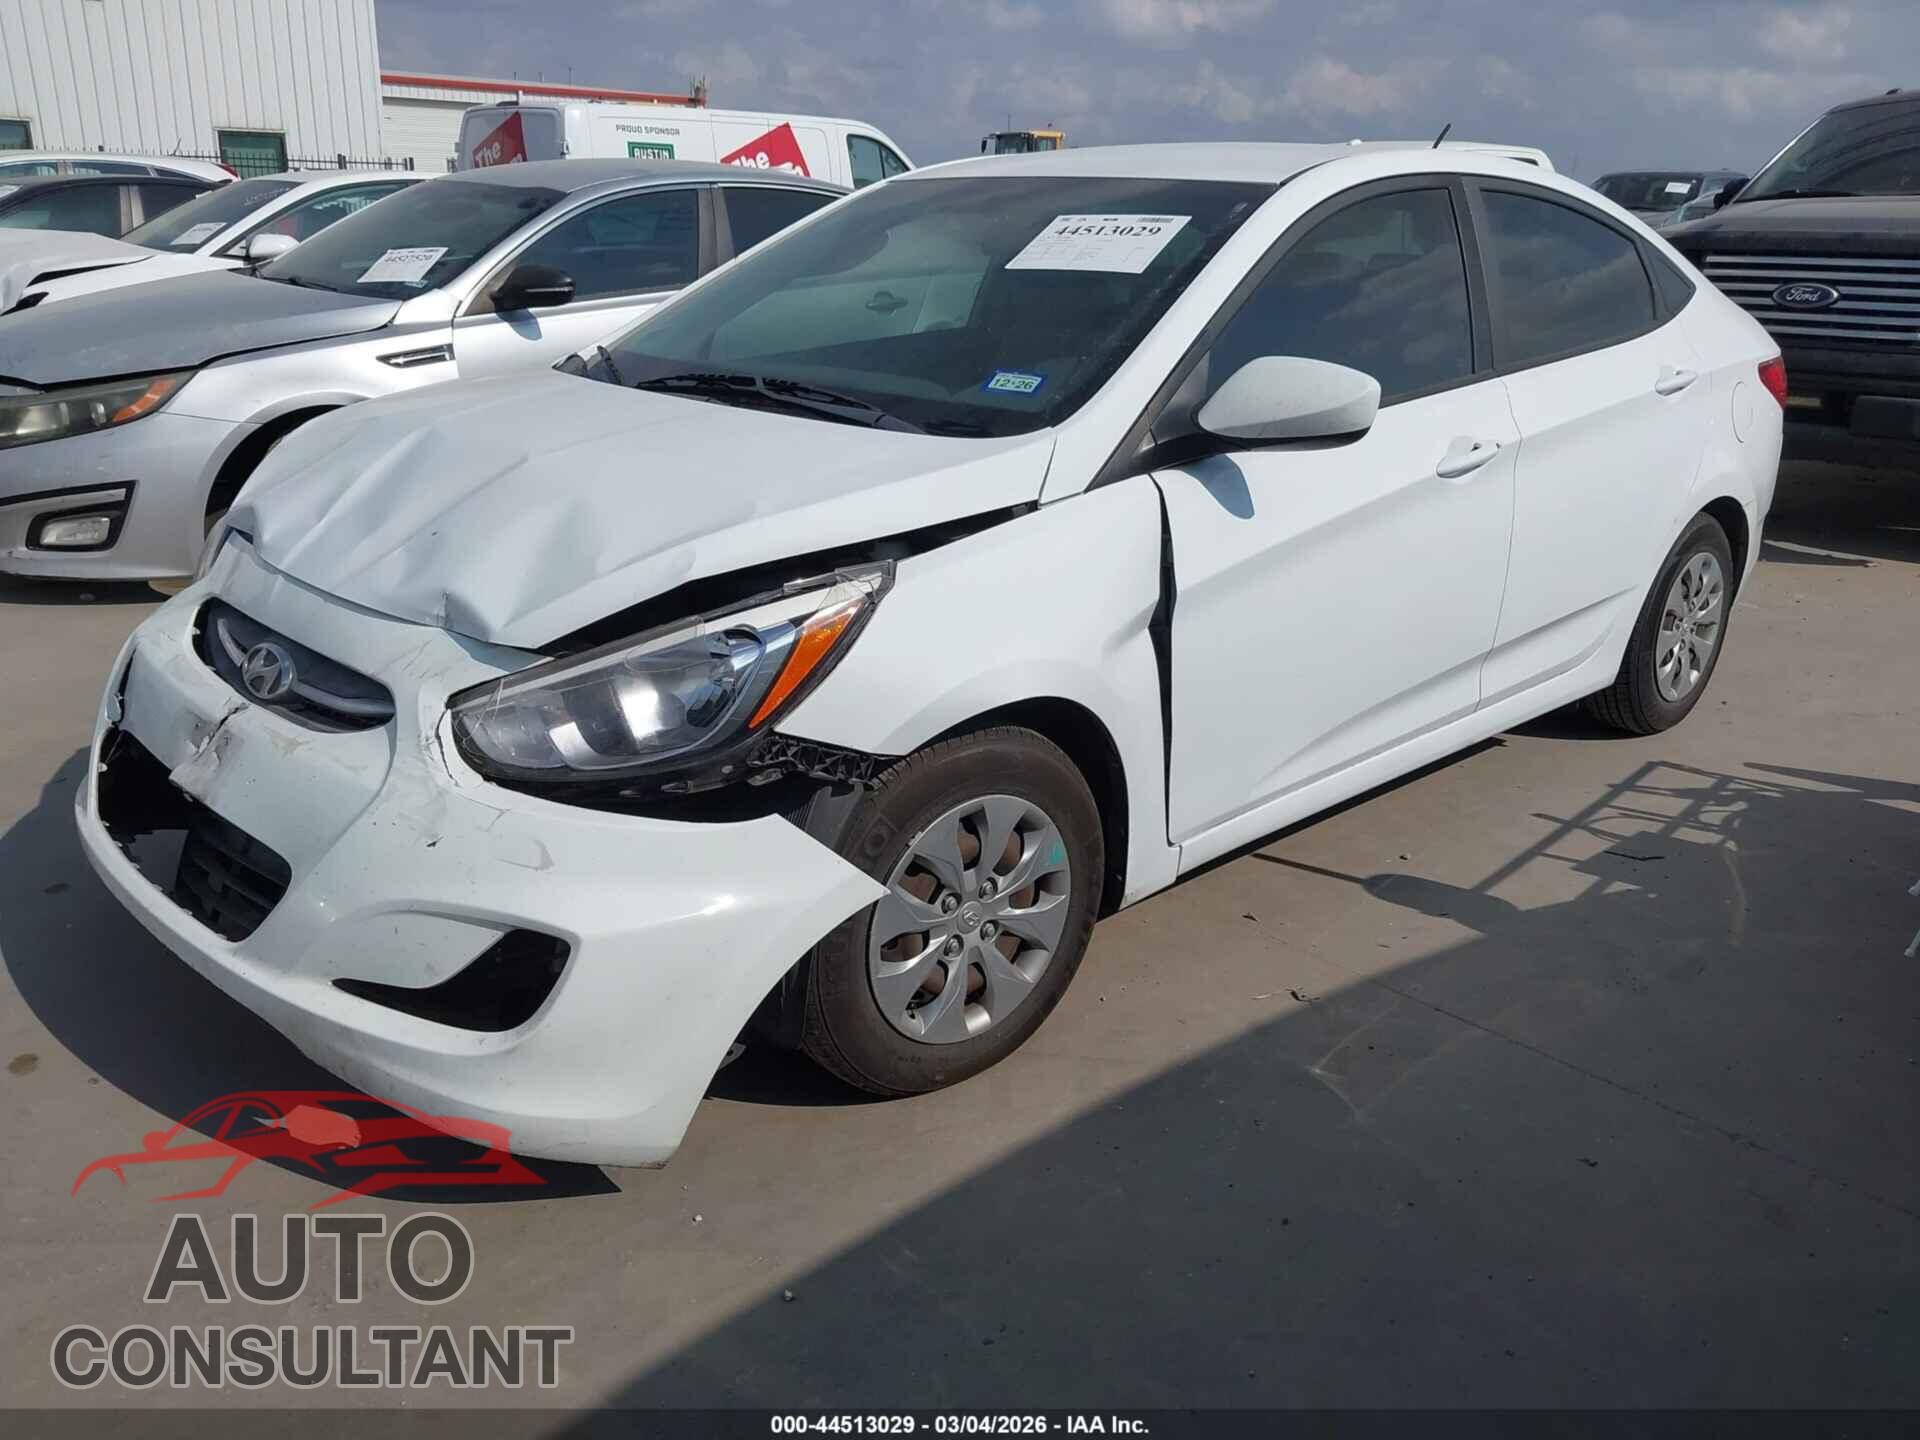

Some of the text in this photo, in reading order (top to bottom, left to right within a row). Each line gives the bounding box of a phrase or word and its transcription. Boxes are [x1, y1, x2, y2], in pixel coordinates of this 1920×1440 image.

[616, 124, 680, 136] PROUD SPONSOR
[634, 148, 670, 160] AUSTIN
[1055, 225, 1162, 236] 44513029
[1786, 287, 1821, 301] Ford
